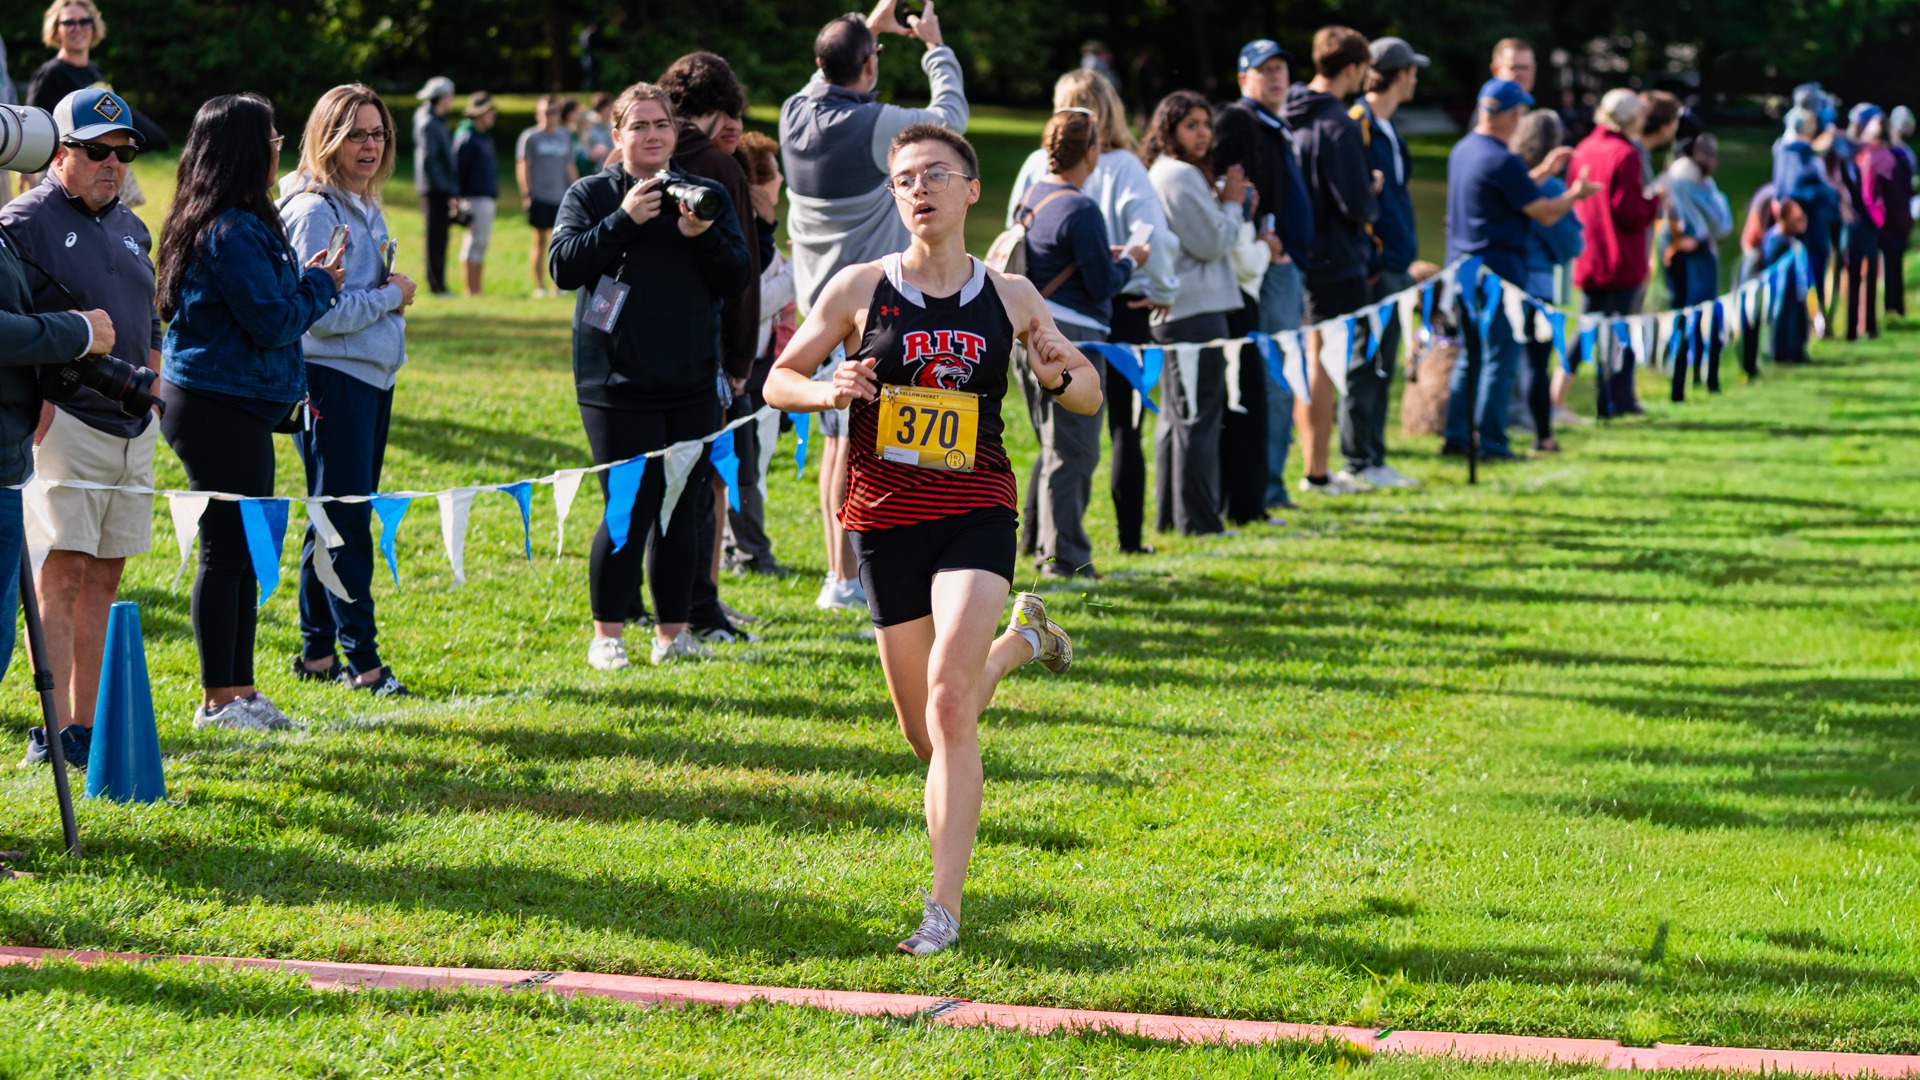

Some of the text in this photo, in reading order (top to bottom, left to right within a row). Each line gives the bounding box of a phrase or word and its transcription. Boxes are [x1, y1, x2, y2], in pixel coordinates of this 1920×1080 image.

[903, 330, 987, 366] RIT
[900, 391, 940, 400] YELLOWJACKET
[896, 406, 960, 449] 370
